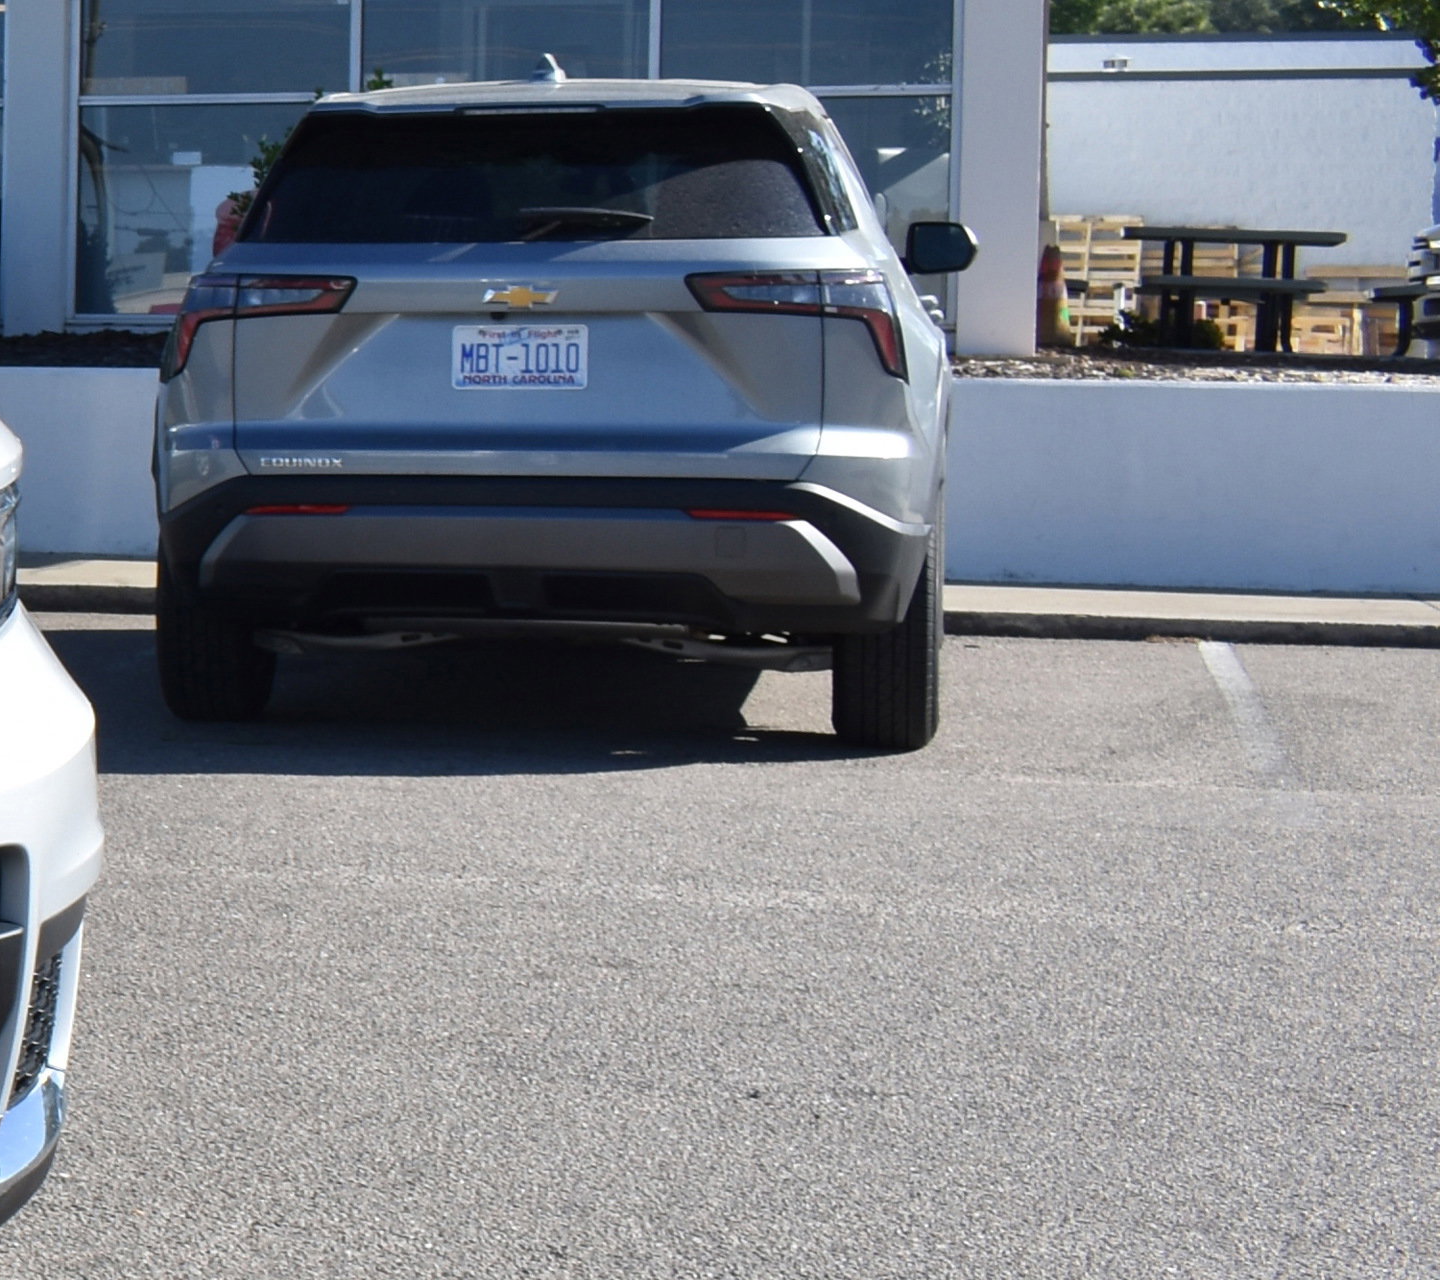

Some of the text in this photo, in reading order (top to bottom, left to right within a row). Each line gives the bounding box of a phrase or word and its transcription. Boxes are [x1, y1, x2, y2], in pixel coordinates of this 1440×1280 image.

[460, 342, 580, 374] MBT-1010
[463, 374, 575, 385] NORTH CAROLINA
[260, 457, 343, 468] EQUINOX
